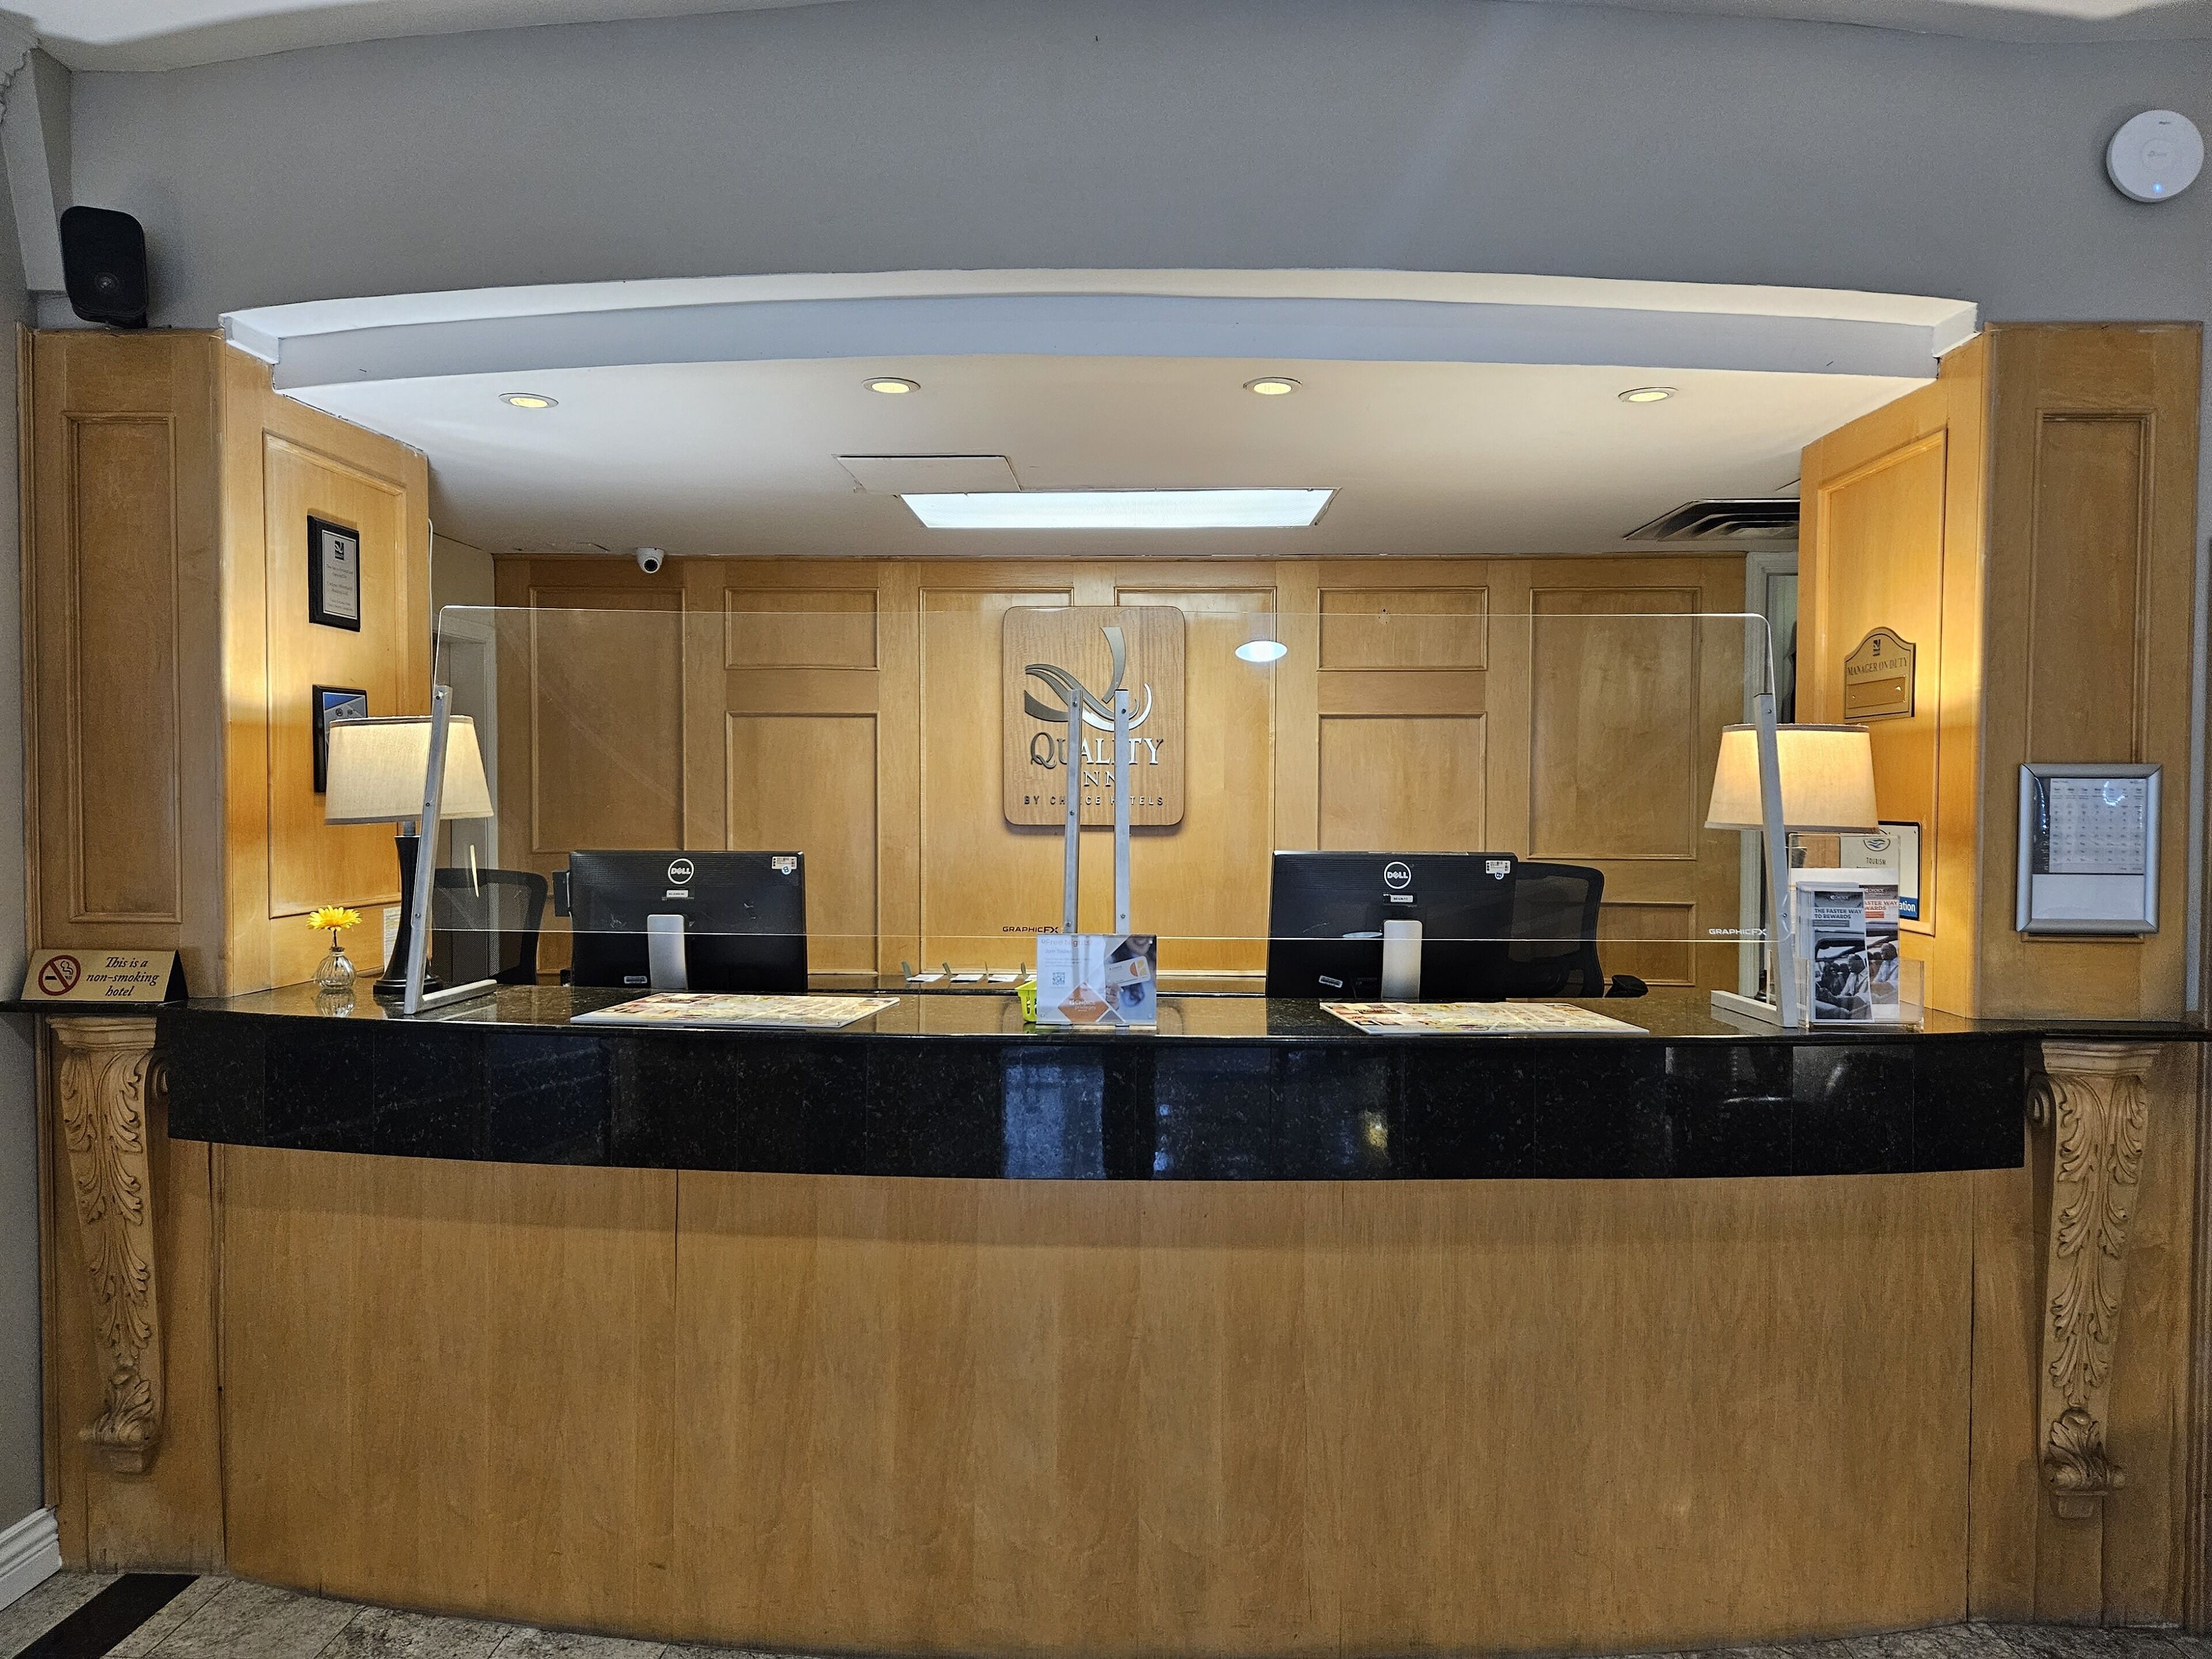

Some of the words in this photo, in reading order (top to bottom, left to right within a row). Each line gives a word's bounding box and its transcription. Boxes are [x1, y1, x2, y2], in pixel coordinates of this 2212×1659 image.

[1847, 662, 1878, 676] MANAGER
[1878, 661, 1888, 671] ON
[1889, 657, 1908, 669] DUTY
[1031, 732, 1164, 769] QUALTY
[1084, 770, 1116, 786] NN
[1024, 796, 1040, 805] BY
[1050, 796, 1101, 805] CHCE
[1111, 796, 1164, 806] HTELS
[1866, 857, 1886, 865] TOURISM
[1387, 871, 1408, 879] DELL
[1899, 900, 1916, 912] ation
[1709, 928, 1767, 936] GRAPHICFX
[105, 956, 127, 968] This
[129, 957, 138, 968] is
[86, 971, 160, 986] non-smoking
[105, 986, 135, 997] hotel
